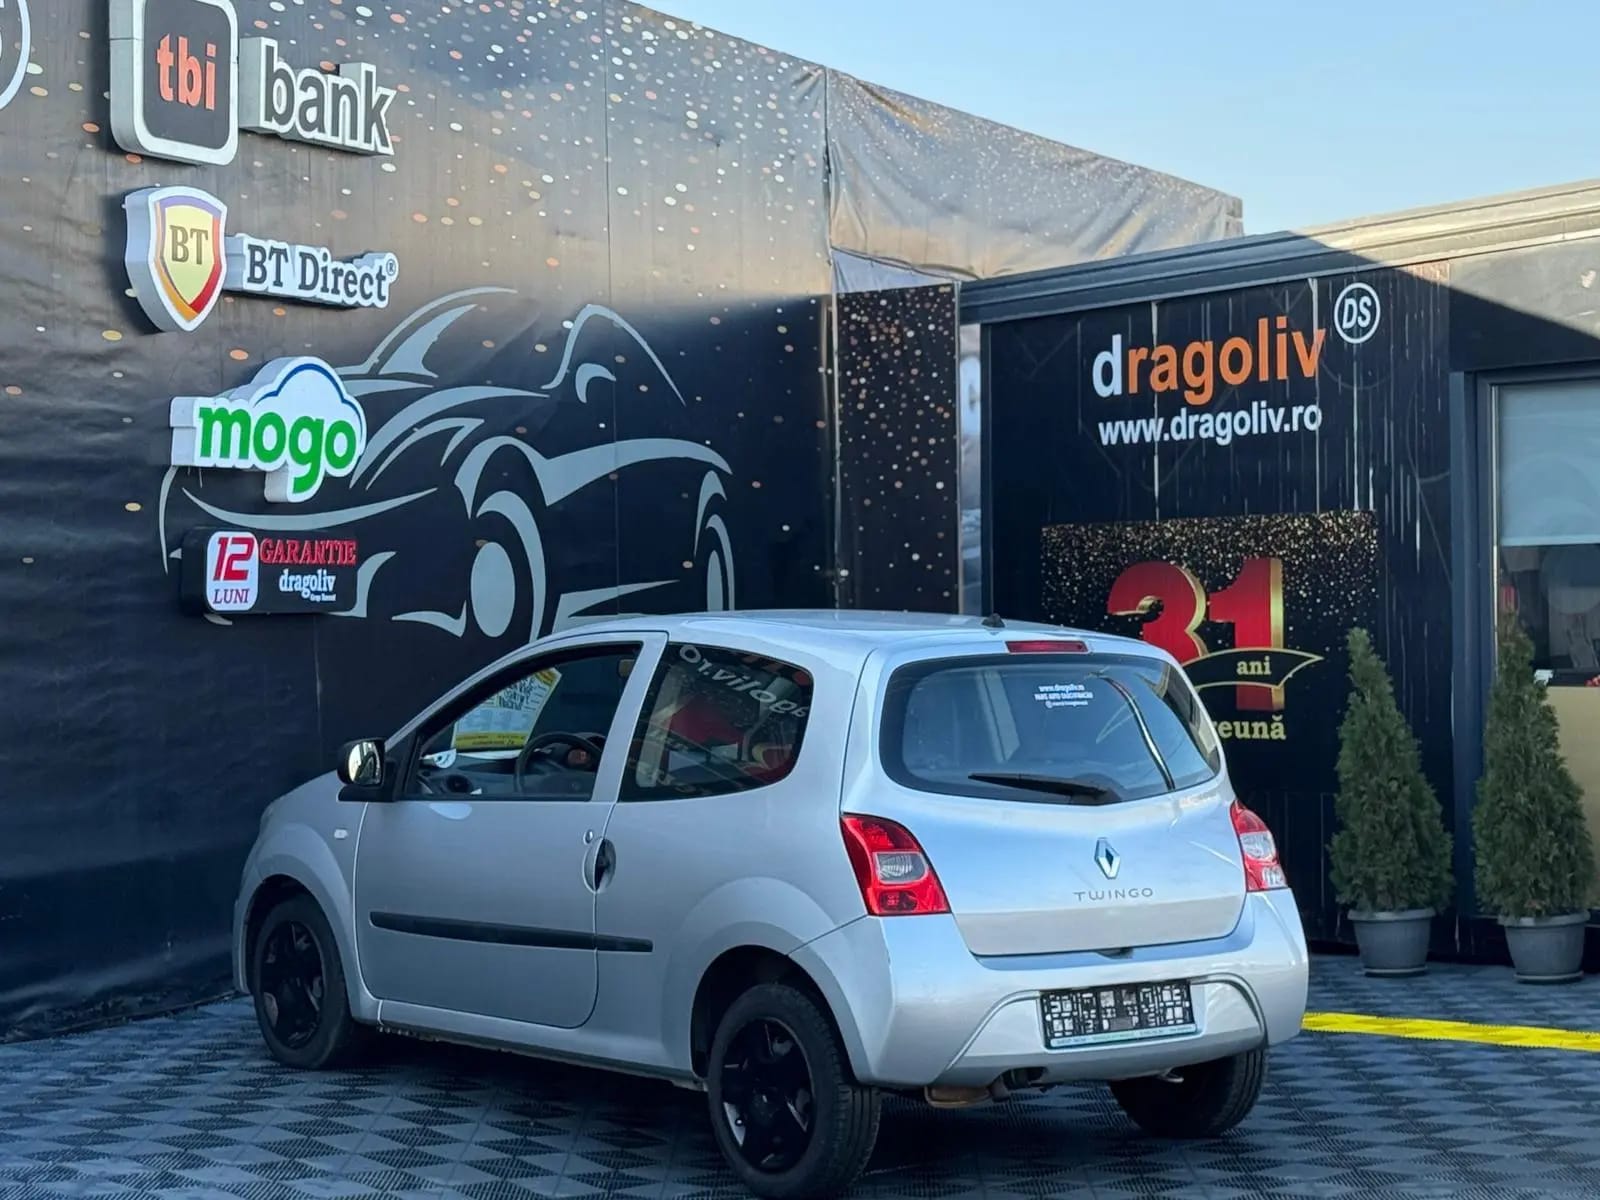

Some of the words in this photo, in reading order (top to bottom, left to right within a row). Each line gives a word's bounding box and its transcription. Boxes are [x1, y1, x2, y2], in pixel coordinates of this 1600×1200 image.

[157, 34, 216, 111] tbi
[264, 45, 393, 152] bank
[169, 224, 209, 267] BT
[247, 243, 289, 288] BT
[1341, 296, 1372, 329] DS
[1092, 315, 1326, 406] dragoliv
[1098, 400, 1323, 446] www.dragoliv.ro
[199, 406, 357, 495] mogo
[212, 536, 255, 581] 12
[259, 538, 357, 566] GARANTIE
[213, 587, 250, 605] LUNI
[279, 568, 336, 598] dragoliv
[1107, 556, 1285, 710] 31
[1236, 655, 1272, 676] ani
[1073, 887, 1154, 902] TWINGO
